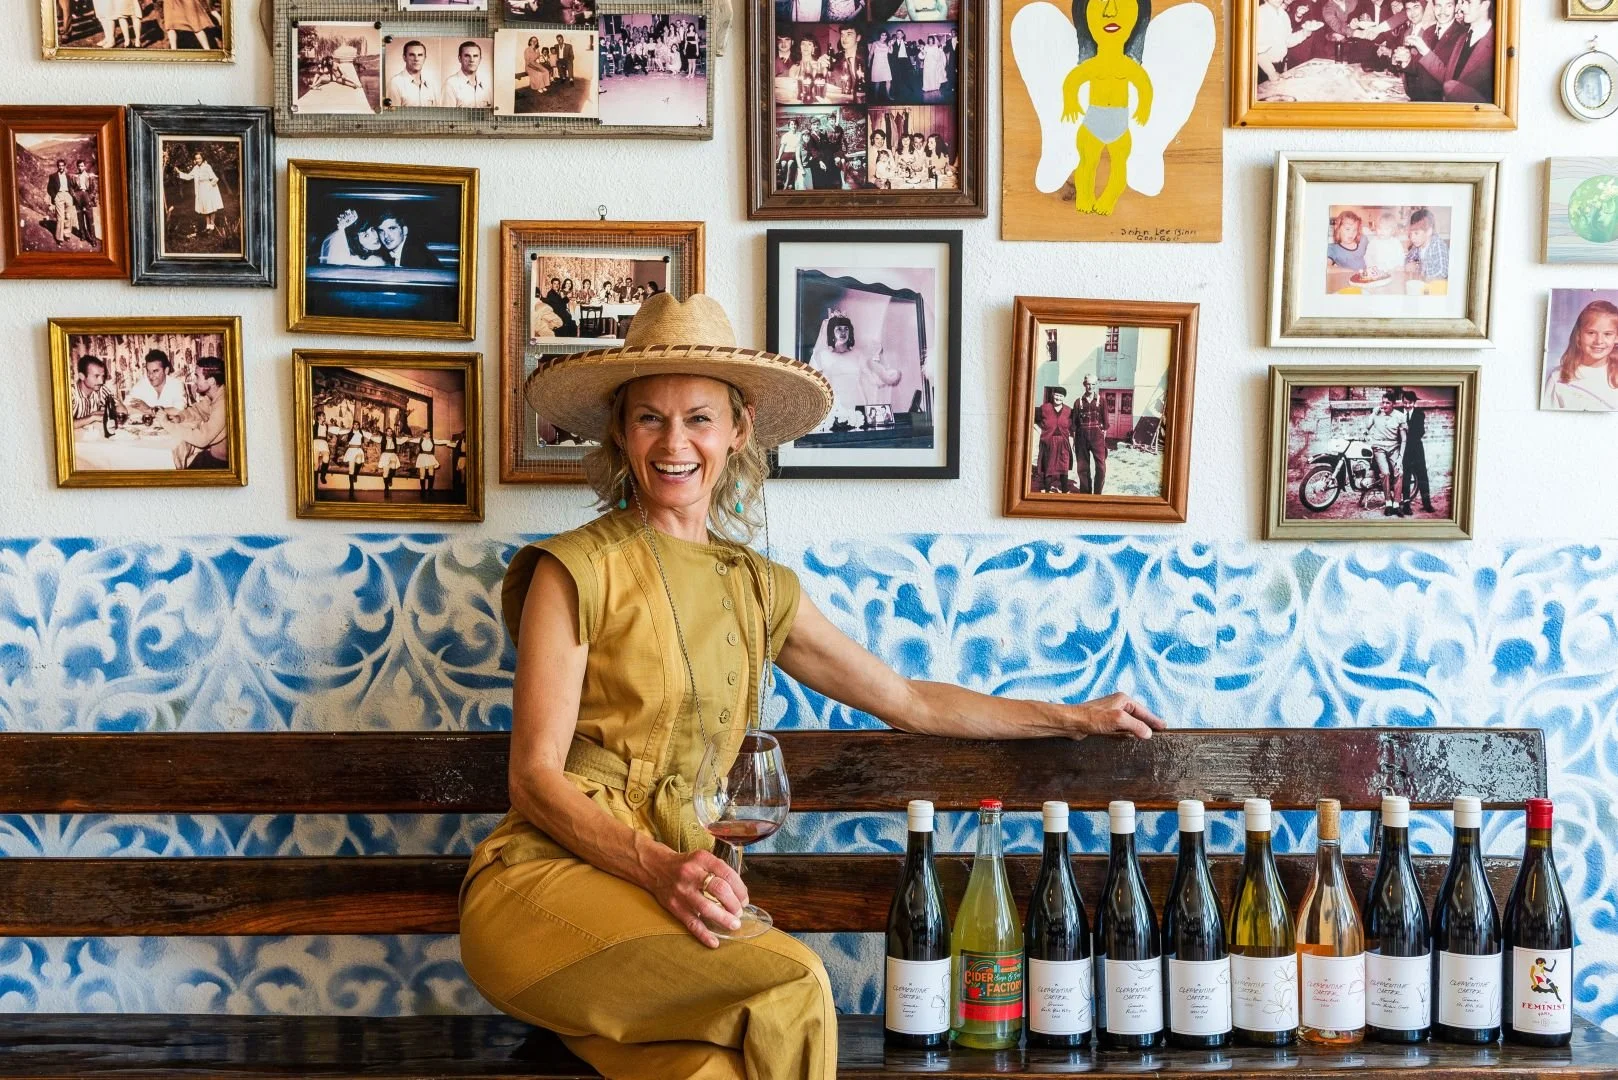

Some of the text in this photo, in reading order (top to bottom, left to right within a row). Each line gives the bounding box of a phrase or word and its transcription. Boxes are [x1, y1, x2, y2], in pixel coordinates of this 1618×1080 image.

[1121, 227, 1149, 236] John
[1155, 227, 1170, 236] Lee
[965, 970, 993, 985] CIDER
[1521, 1001, 1566, 1011] FEMINIST
